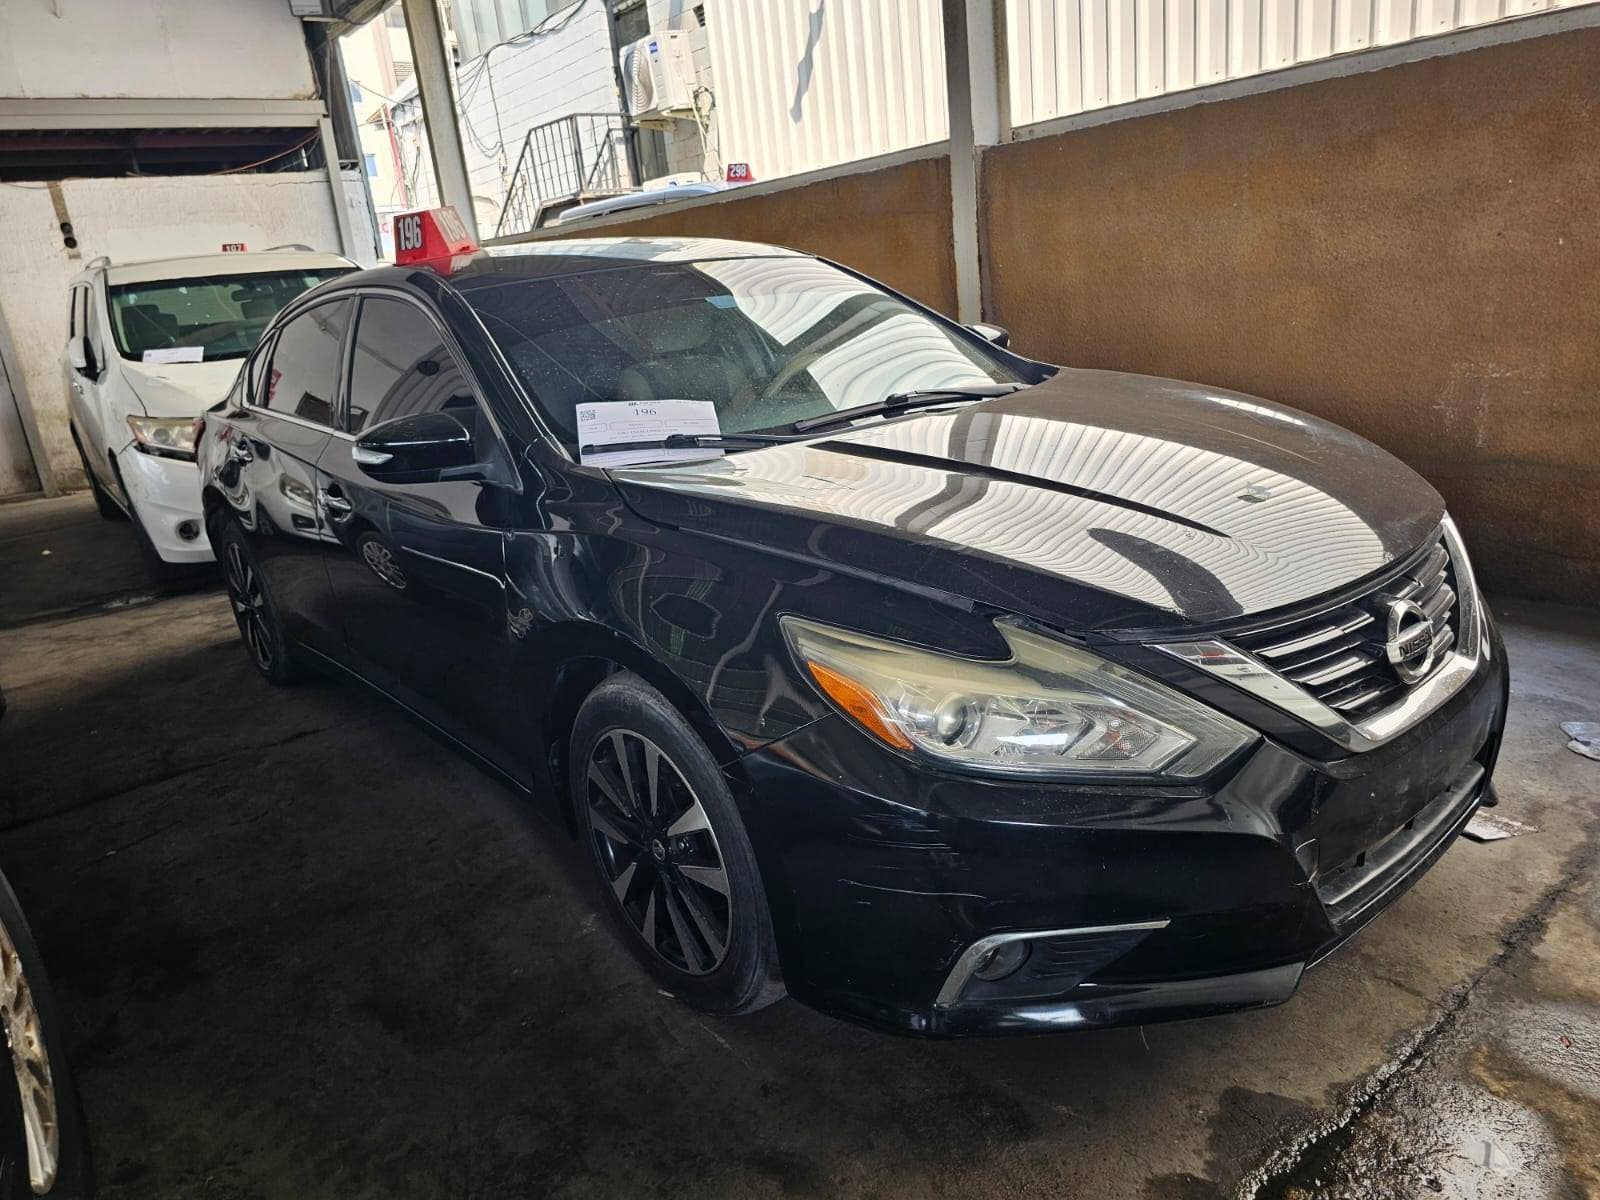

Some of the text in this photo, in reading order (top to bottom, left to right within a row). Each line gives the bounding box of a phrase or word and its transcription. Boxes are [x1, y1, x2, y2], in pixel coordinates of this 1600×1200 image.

[730, 164, 747, 177] 298
[398, 215, 422, 251] 196
[634, 407, 657, 416] 196
